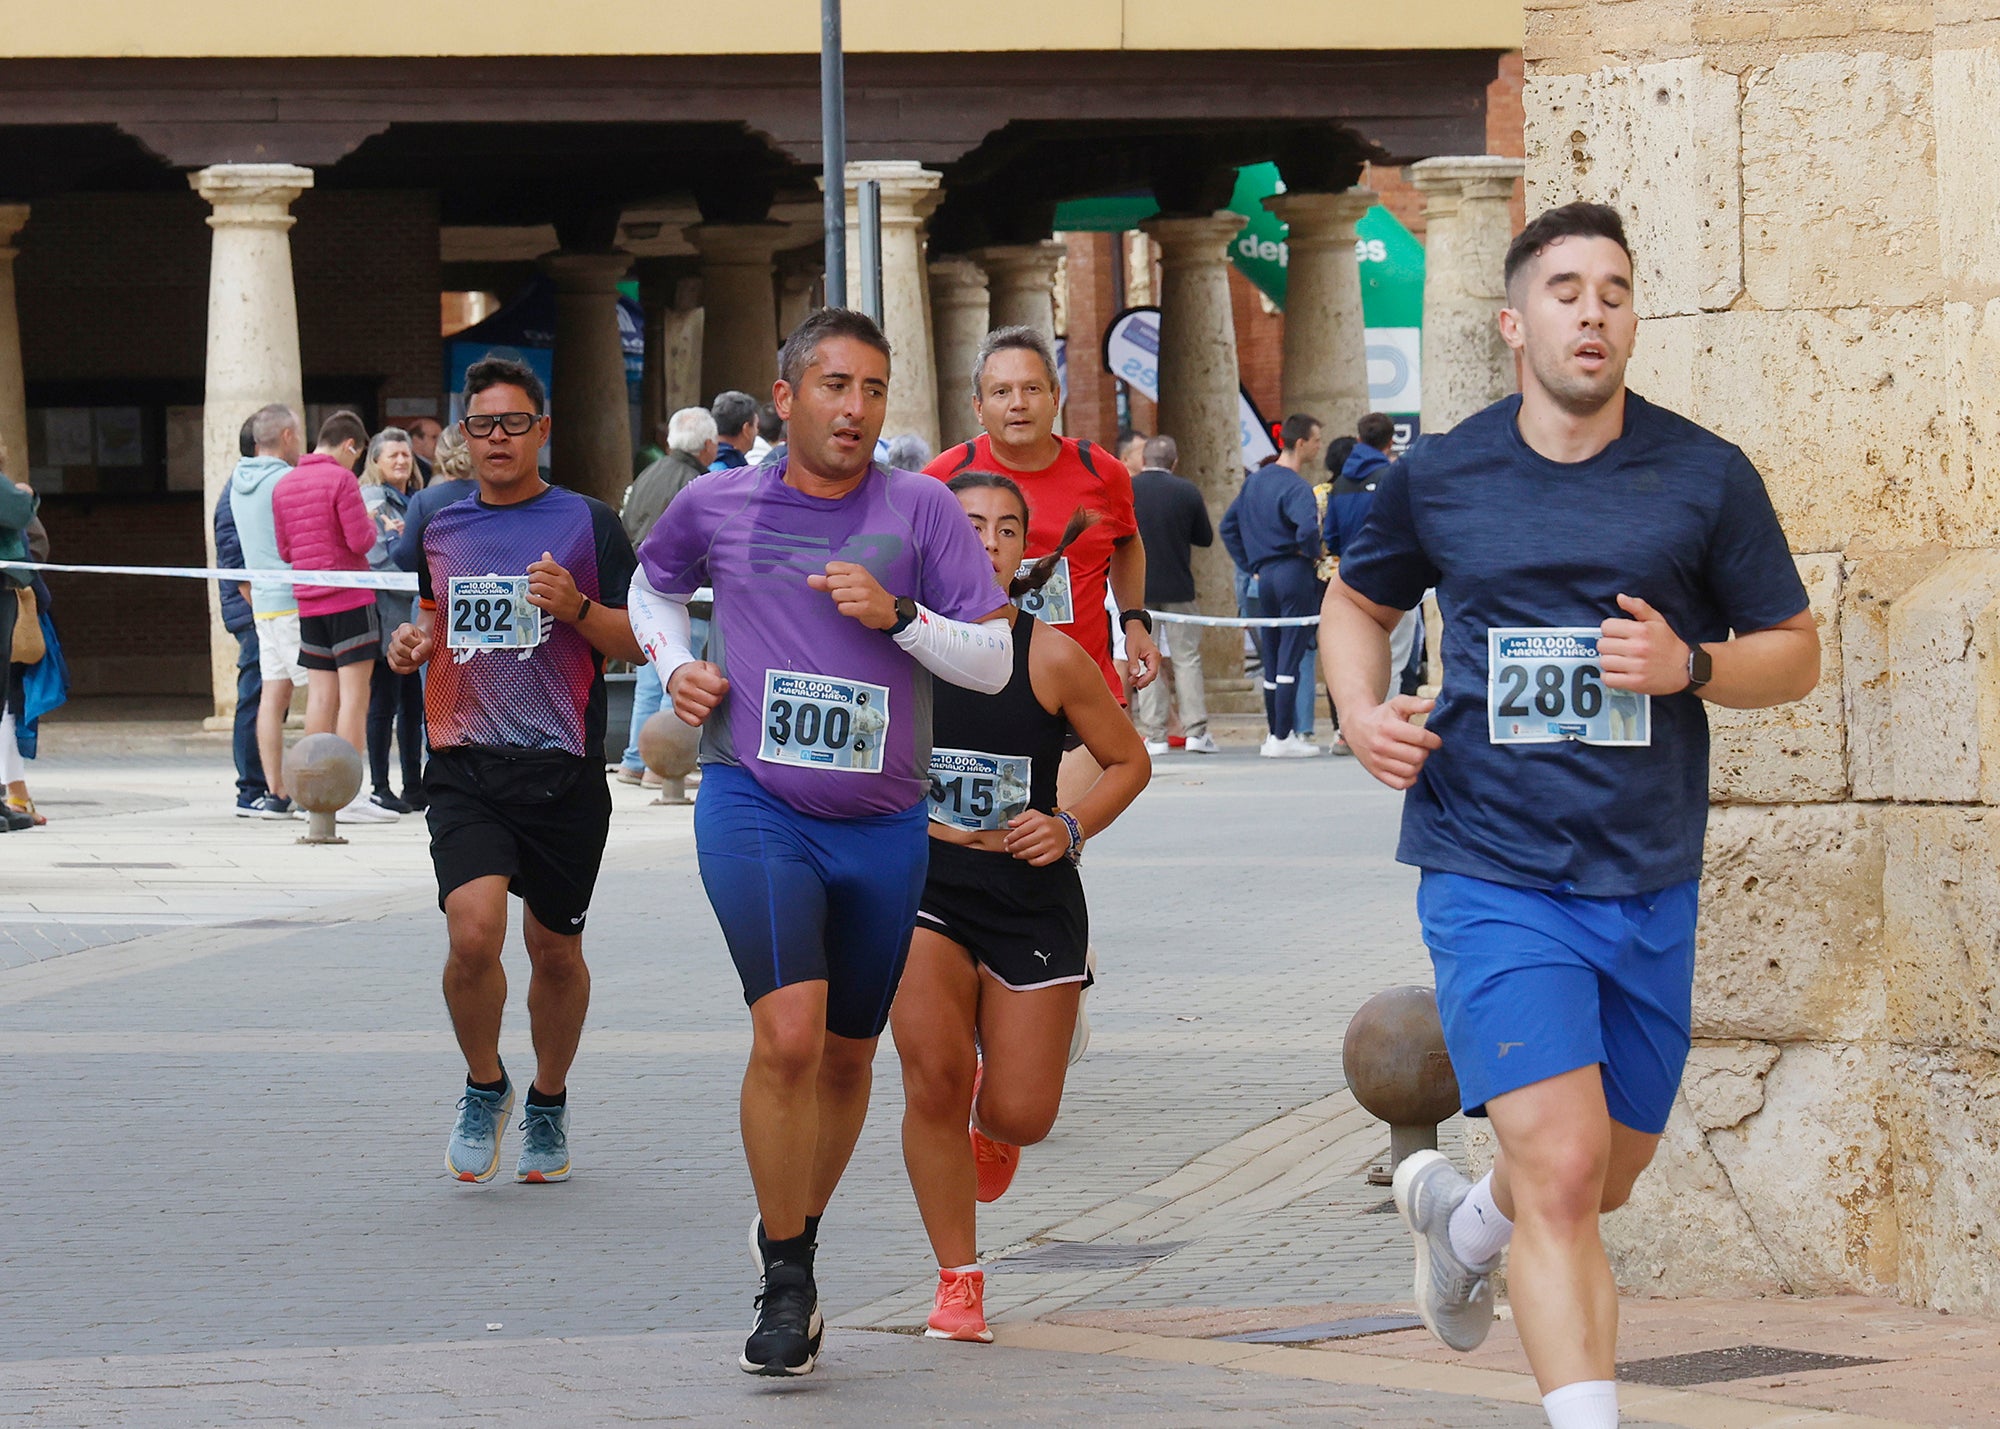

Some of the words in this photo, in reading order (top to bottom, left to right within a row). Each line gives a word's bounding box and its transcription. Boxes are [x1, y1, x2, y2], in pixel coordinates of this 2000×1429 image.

[454, 599, 512, 632] 282
[1526, 637, 1576, 649] 10.000
[1563, 648, 1596, 657] HARO
[794, 680, 832, 693] 10.000
[1498, 664, 1602, 719] 286
[821, 692, 848, 702] HARO
[769, 699, 850, 749] 300
[940, 756, 977, 766] 10.000
[966, 765, 992, 773] HARO
